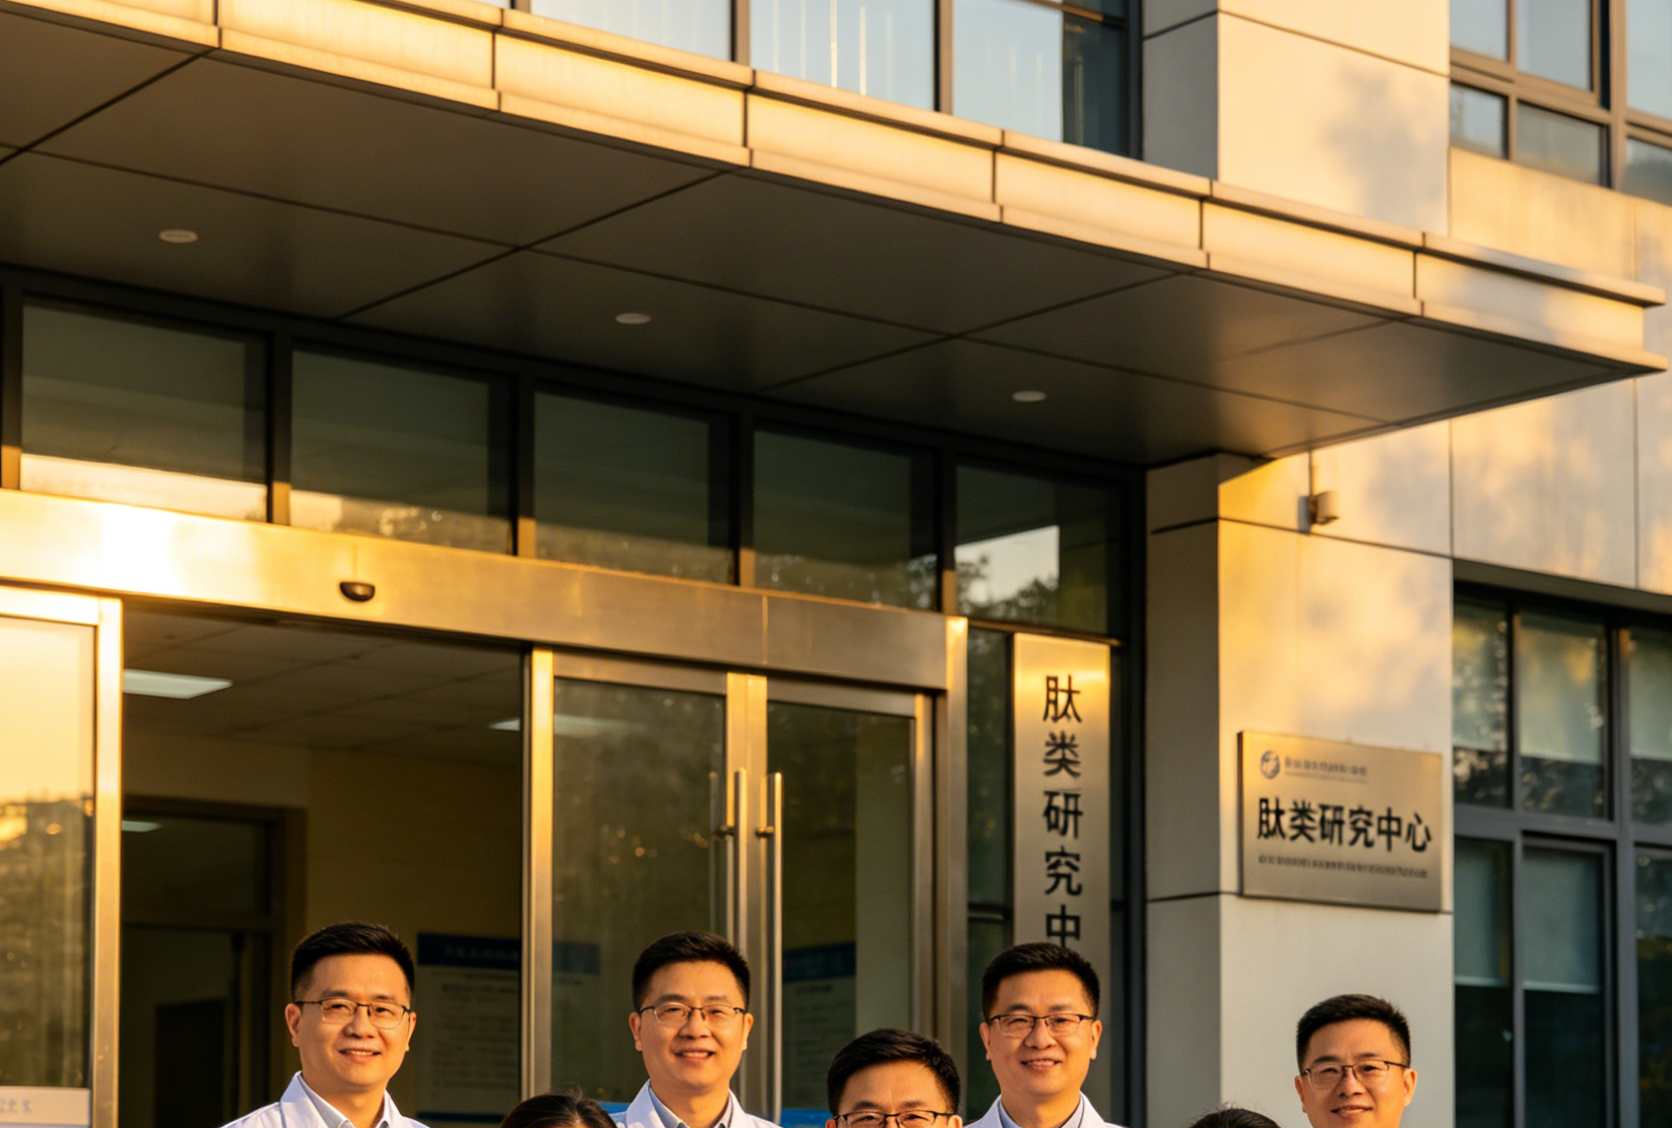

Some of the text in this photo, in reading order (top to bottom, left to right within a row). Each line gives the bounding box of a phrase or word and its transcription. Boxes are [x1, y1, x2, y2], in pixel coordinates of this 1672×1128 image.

[1257, 796, 1432, 852] 肽类研究中心
